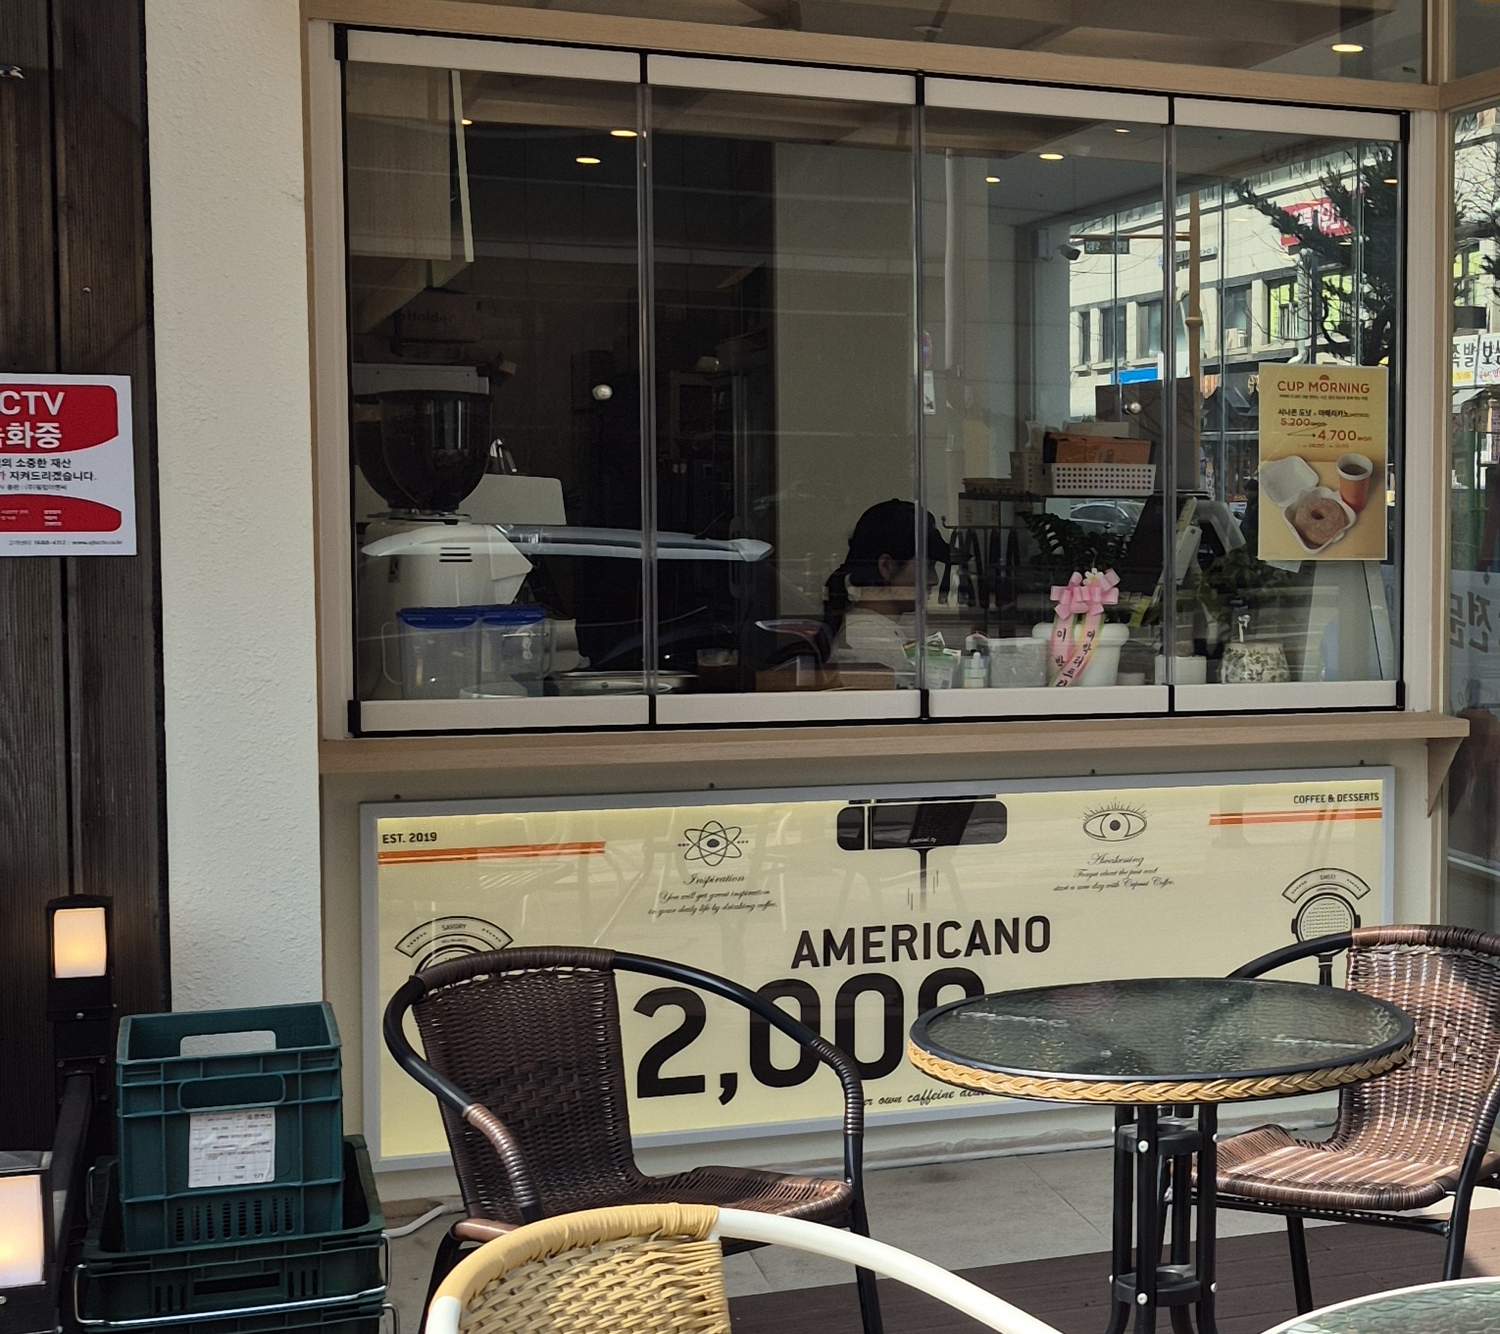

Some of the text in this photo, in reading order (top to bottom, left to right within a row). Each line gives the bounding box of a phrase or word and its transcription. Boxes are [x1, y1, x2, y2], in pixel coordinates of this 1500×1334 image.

[1277, 381, 1370, 394] CUP MORNING
[0, 421, 63, 449] 화중
[0, 457, 71, 469] 의 소중한 재산
[9, 470, 97, 482] 지켜드리겠습니다.
[1293, 792, 1380, 804] COFFEE & DESSERTS
[382, 831, 437, 844] EST. 2019
[1087, 852, 1145, 867] Awakening
[683, 872, 745, 888] Inspiration
[1073, 868, 1099, 881] Forget
[1099, 869, 1118, 877] about
[1118, 868, 1129, 876] the
[1091, 881, 1105, 892] day
[1122, 877, 1149, 890] Cupnut
[658, 890, 679, 904] You
[680, 891, 696, 900] will
[656, 907, 677, 918] your
[677, 904, 697, 916] daily
[698, 903, 711, 914] life
[711, 903, 721, 916] by
[721, 901, 756, 913] drinking
[790, 914, 1051, 969] AMERICANO
[878, 1095, 902, 1105] own
[907, 1088, 955, 1106] caffeine
